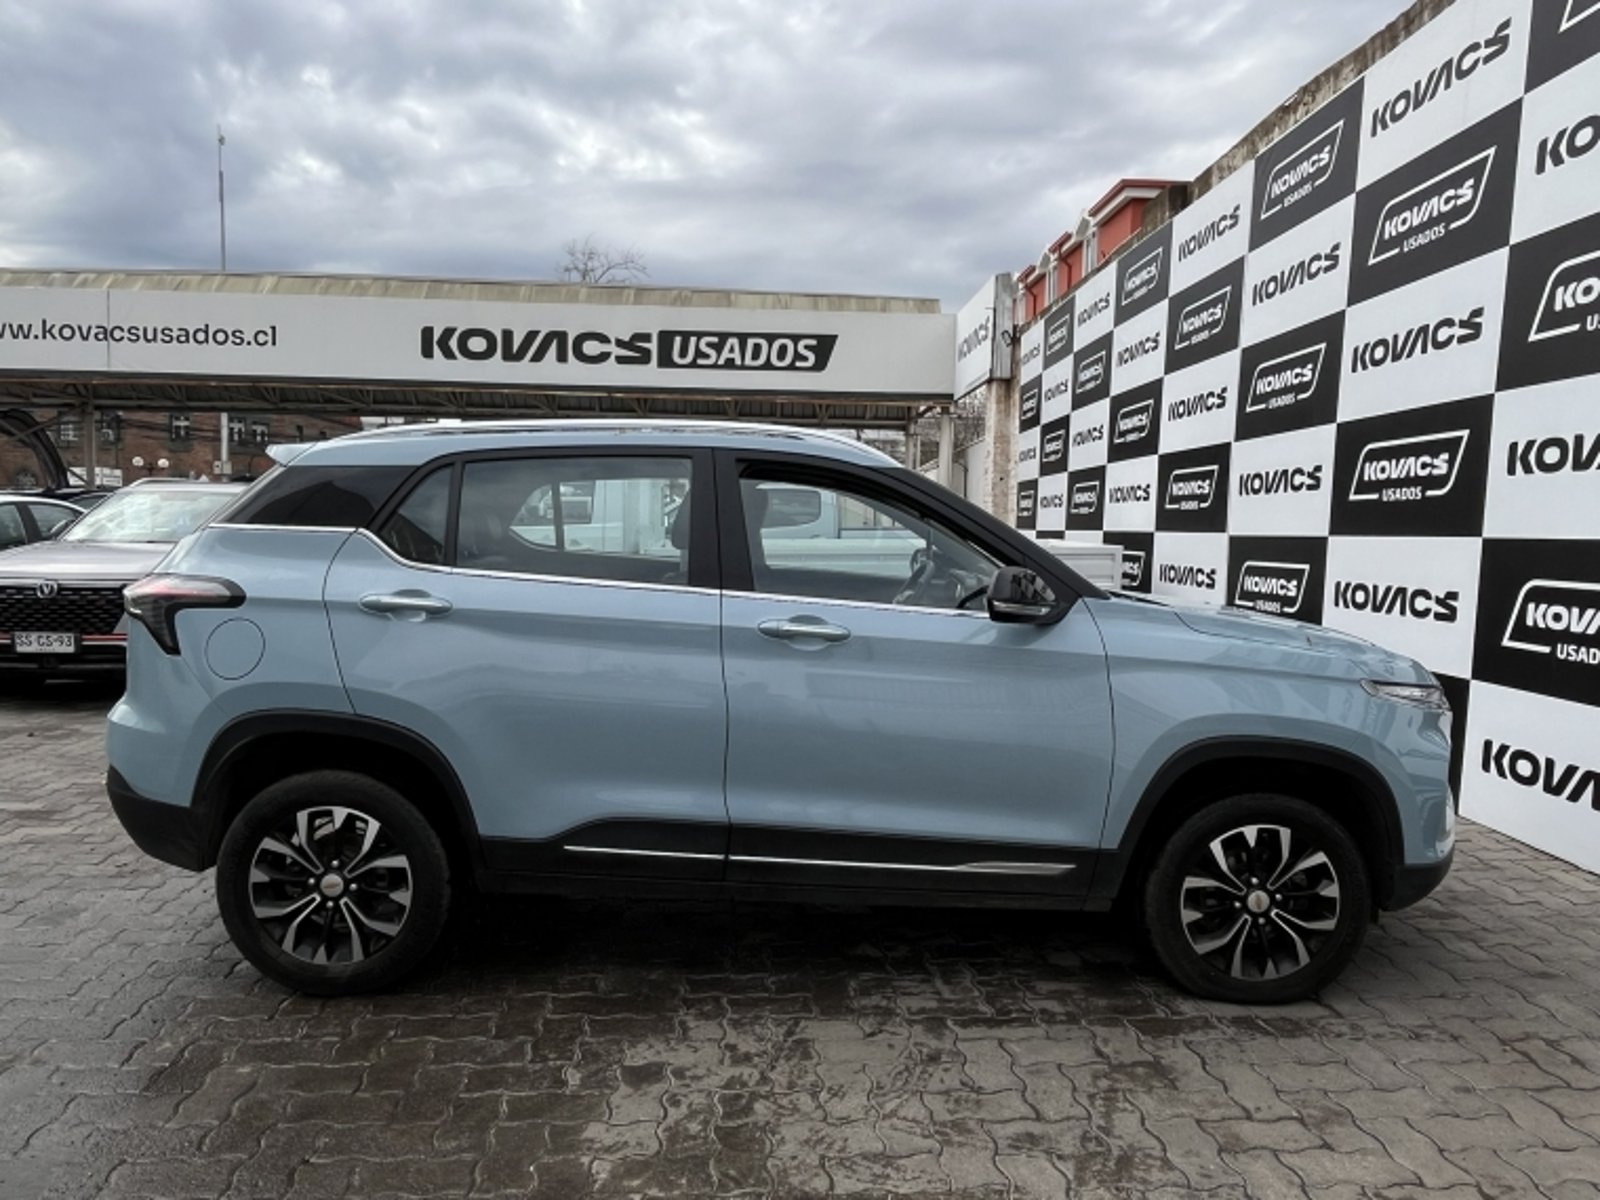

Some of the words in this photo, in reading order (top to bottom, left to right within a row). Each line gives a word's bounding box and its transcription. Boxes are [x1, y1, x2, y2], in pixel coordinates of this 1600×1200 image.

[1370, 17, 1512, 138] KOVACS
[1535, 114, 1600, 175] KO
[1270, 145, 1332, 199] KOVACS
[1384, 178, 1475, 240] KOVACS
[1178, 204, 1241, 262] KOVACS
[1402, 222, 1446, 253] USADOS
[1252, 241, 1342, 307] KOVACS
[420, 325, 653, 365] KOVACS
[671, 335, 818, 368] USADOS
[1351, 306, 1485, 373] KOVACS
[1256, 363, 1314, 395] KOVACS
[1168, 386, 1228, 421] KOVACS
[1363, 452, 1449, 481] KOVACS
[1507, 433, 1600, 476] KOV
[1239, 465, 1323, 497] KOVACS
[1382, 486, 1422, 501] USADOS
[1159, 564, 1217, 590] KOVACS
[1243, 575, 1298, 597] KOVACS
[1334, 580, 1460, 623] KOVACS
